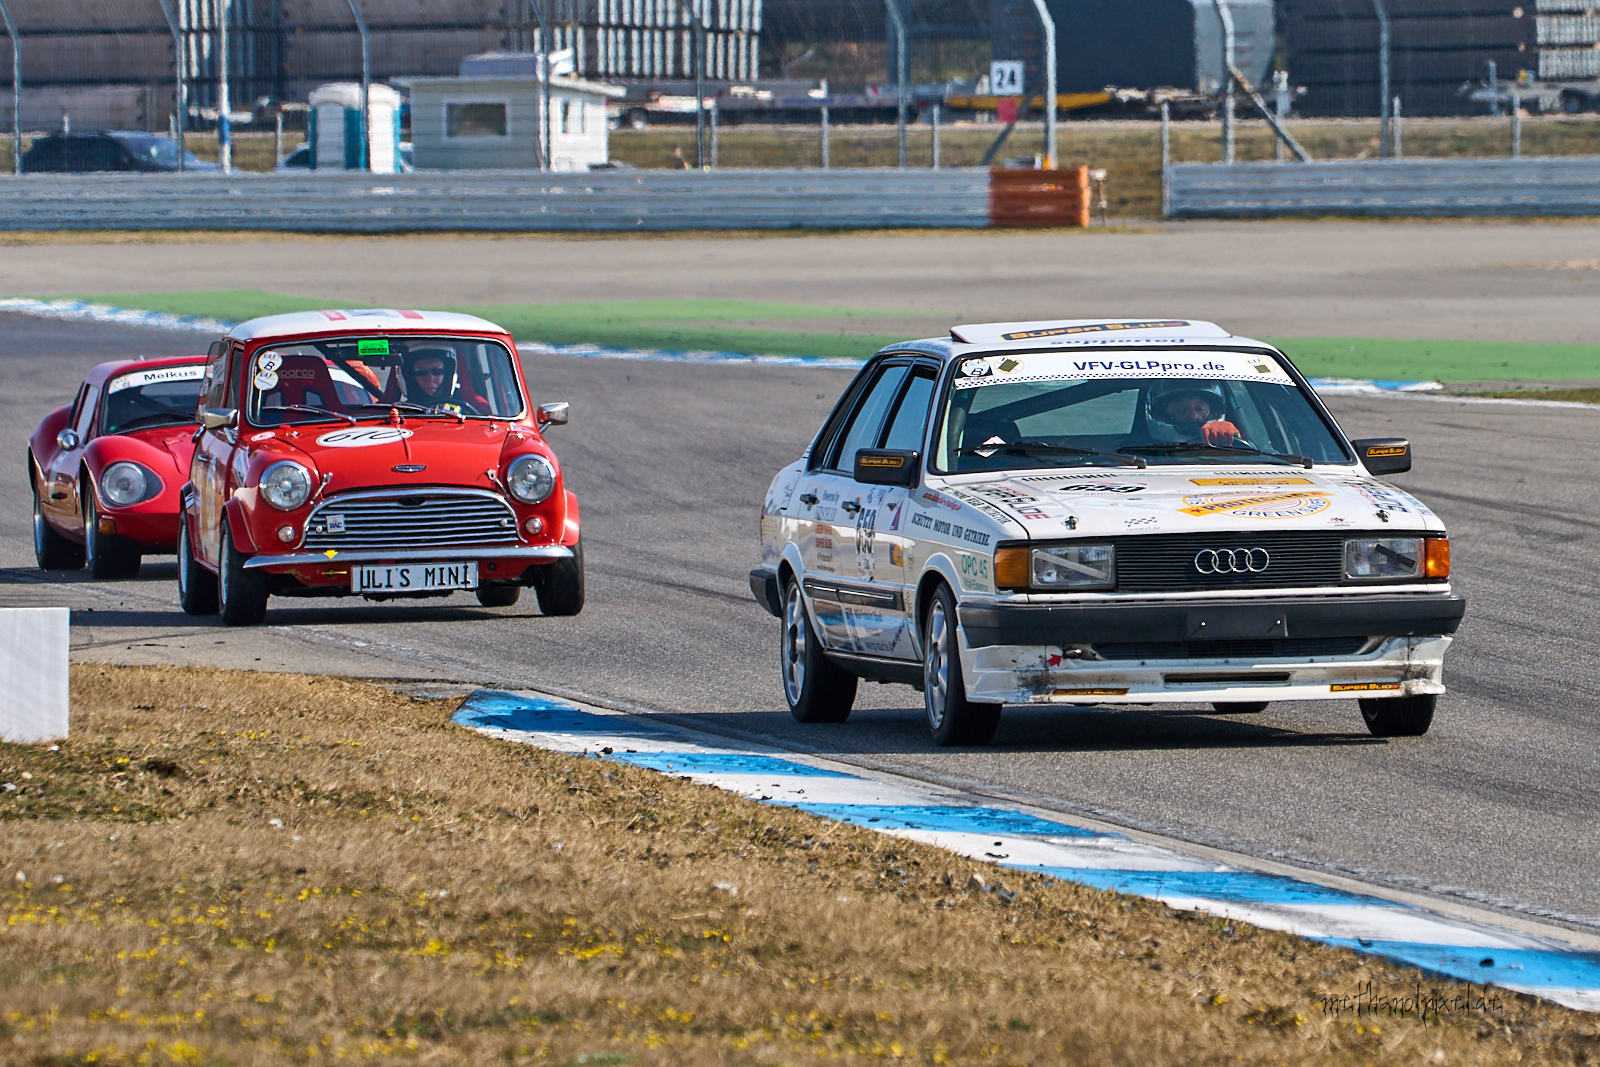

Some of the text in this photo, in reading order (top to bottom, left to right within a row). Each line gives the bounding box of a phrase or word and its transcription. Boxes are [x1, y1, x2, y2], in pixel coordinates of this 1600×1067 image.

[995, 68, 1016, 88] 24
[264, 361, 275, 371] B
[970, 367, 984, 376] B
[1072, 360, 1226, 373] VFV-GLPpro.de
[143, 370, 197, 381] Melkus
[911, 511, 933, 530] SCHÜTZT
[933, 517, 951, 536] MOTOR
[952, 524, 963, 539] UND
[961, 554, 988, 579] OPC 45
[425, 565, 471, 587] MINI
